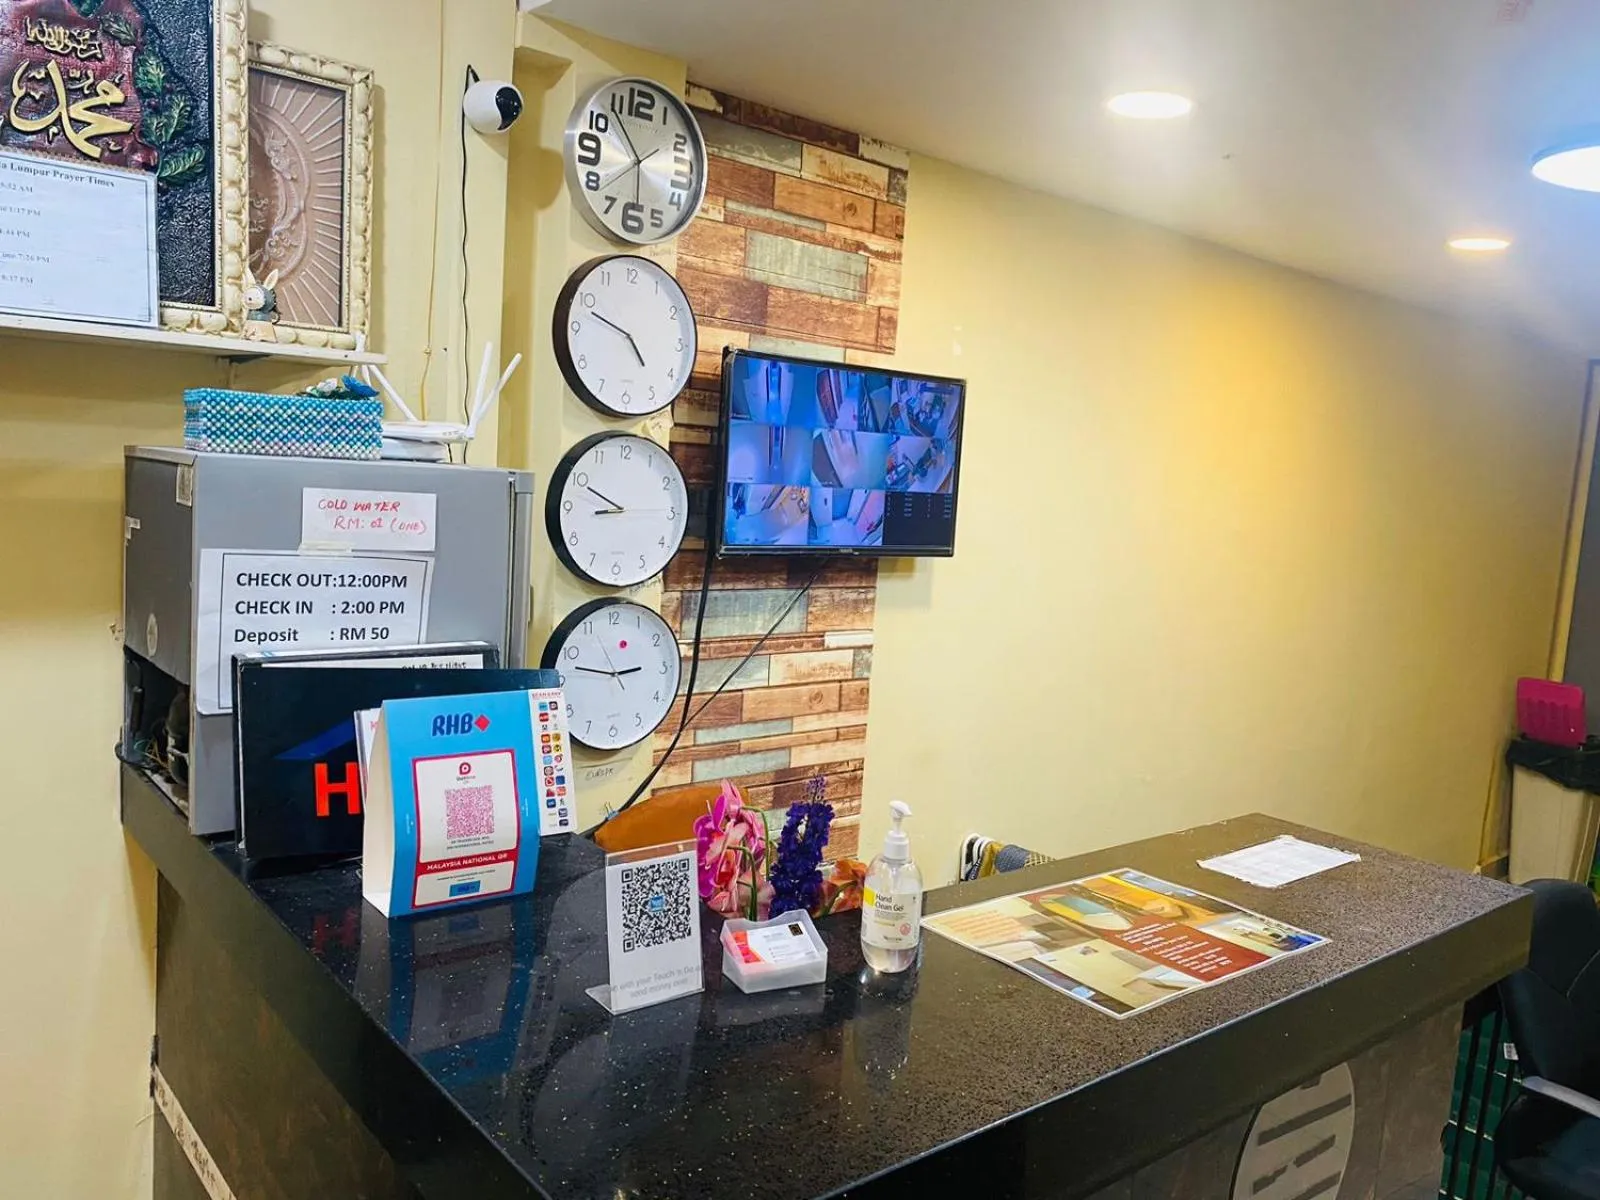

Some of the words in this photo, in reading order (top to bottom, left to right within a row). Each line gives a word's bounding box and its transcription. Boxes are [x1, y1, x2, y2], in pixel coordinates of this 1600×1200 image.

[611, 93, 624, 115] 11
[627, 87, 656, 122] 12
[589, 110, 608, 133] 10
[662, 106, 668, 126] 1
[577, 132, 602, 167] 9
[673, 133, 687, 153] 2
[10, 162, 51, 176] Lumpur
[53, 169, 86, 183] Prayer
[86, 175, 115, 188] Times
[585, 171, 600, 191] 8
[670, 156, 693, 191] 3
[604, 195, 618, 215] 7
[668, 192, 682, 212] 4
[621, 201, 645, 235] 6
[650, 208, 664, 228] 5
[601, 270, 611, 286] 11
[626, 268, 639, 284] 12
[655, 280, 659, 295] 1
[579, 292, 596, 309] 10
[669, 305, 677, 321] 2
[570, 320, 581, 336] 9
[675, 338, 684, 353] 3
[577, 354, 587, 370] 8
[667, 368, 674, 381] 4
[599, 378, 605, 392] 7
[621, 389, 631, 404] 6
[648, 386, 656, 400] 5
[594, 450, 604, 465] 11
[620, 444, 632, 460] 12
[648, 455, 652, 468] 1
[572, 472, 589, 488] 10
[662, 476, 671, 491] 2
[318, 499, 348, 511] COLD
[353, 501, 401, 513] WATER
[562, 499, 573, 515] 9
[666, 506, 676, 521] 3
[334, 515, 365, 530] RM:
[568, 531, 579, 547] 8
[658, 536, 666, 548] 4
[589, 552, 597, 567] 7
[638, 555, 646, 570] 5
[611, 560, 622, 576] 6
[236, 572, 292, 588] CHECK
[296, 573, 408, 589] OUT:12:00PM
[234, 600, 291, 615] CHECK
[295, 600, 313, 615] IN
[340, 600, 375, 615] 2:00
[379, 600, 406, 615] PM
[609, 612, 620, 625] 12
[636, 616, 641, 629] 1
[583, 621, 593, 635] 11
[233, 627, 299, 646] Deposit
[339, 627, 367, 641] RM
[370, 626, 390, 641] 50
[652, 633, 661, 647] 2
[563, 645, 580, 660] 10
[659, 661, 668, 675] 3
[653, 691, 660, 703] 4
[566, 704, 574, 718] 8
[431, 713, 474, 737] RHB
[635, 712, 643, 727] 5
[586, 721, 593, 735] 7
[608, 725, 618, 738] 6
[426, 861, 462, 871] MALAYSIA
[462, 855, 496, 866] NATIONAL
[876, 893, 893, 903] Hand
[876, 901, 893, 912] Clean
[893, 904, 905, 912] Gel
